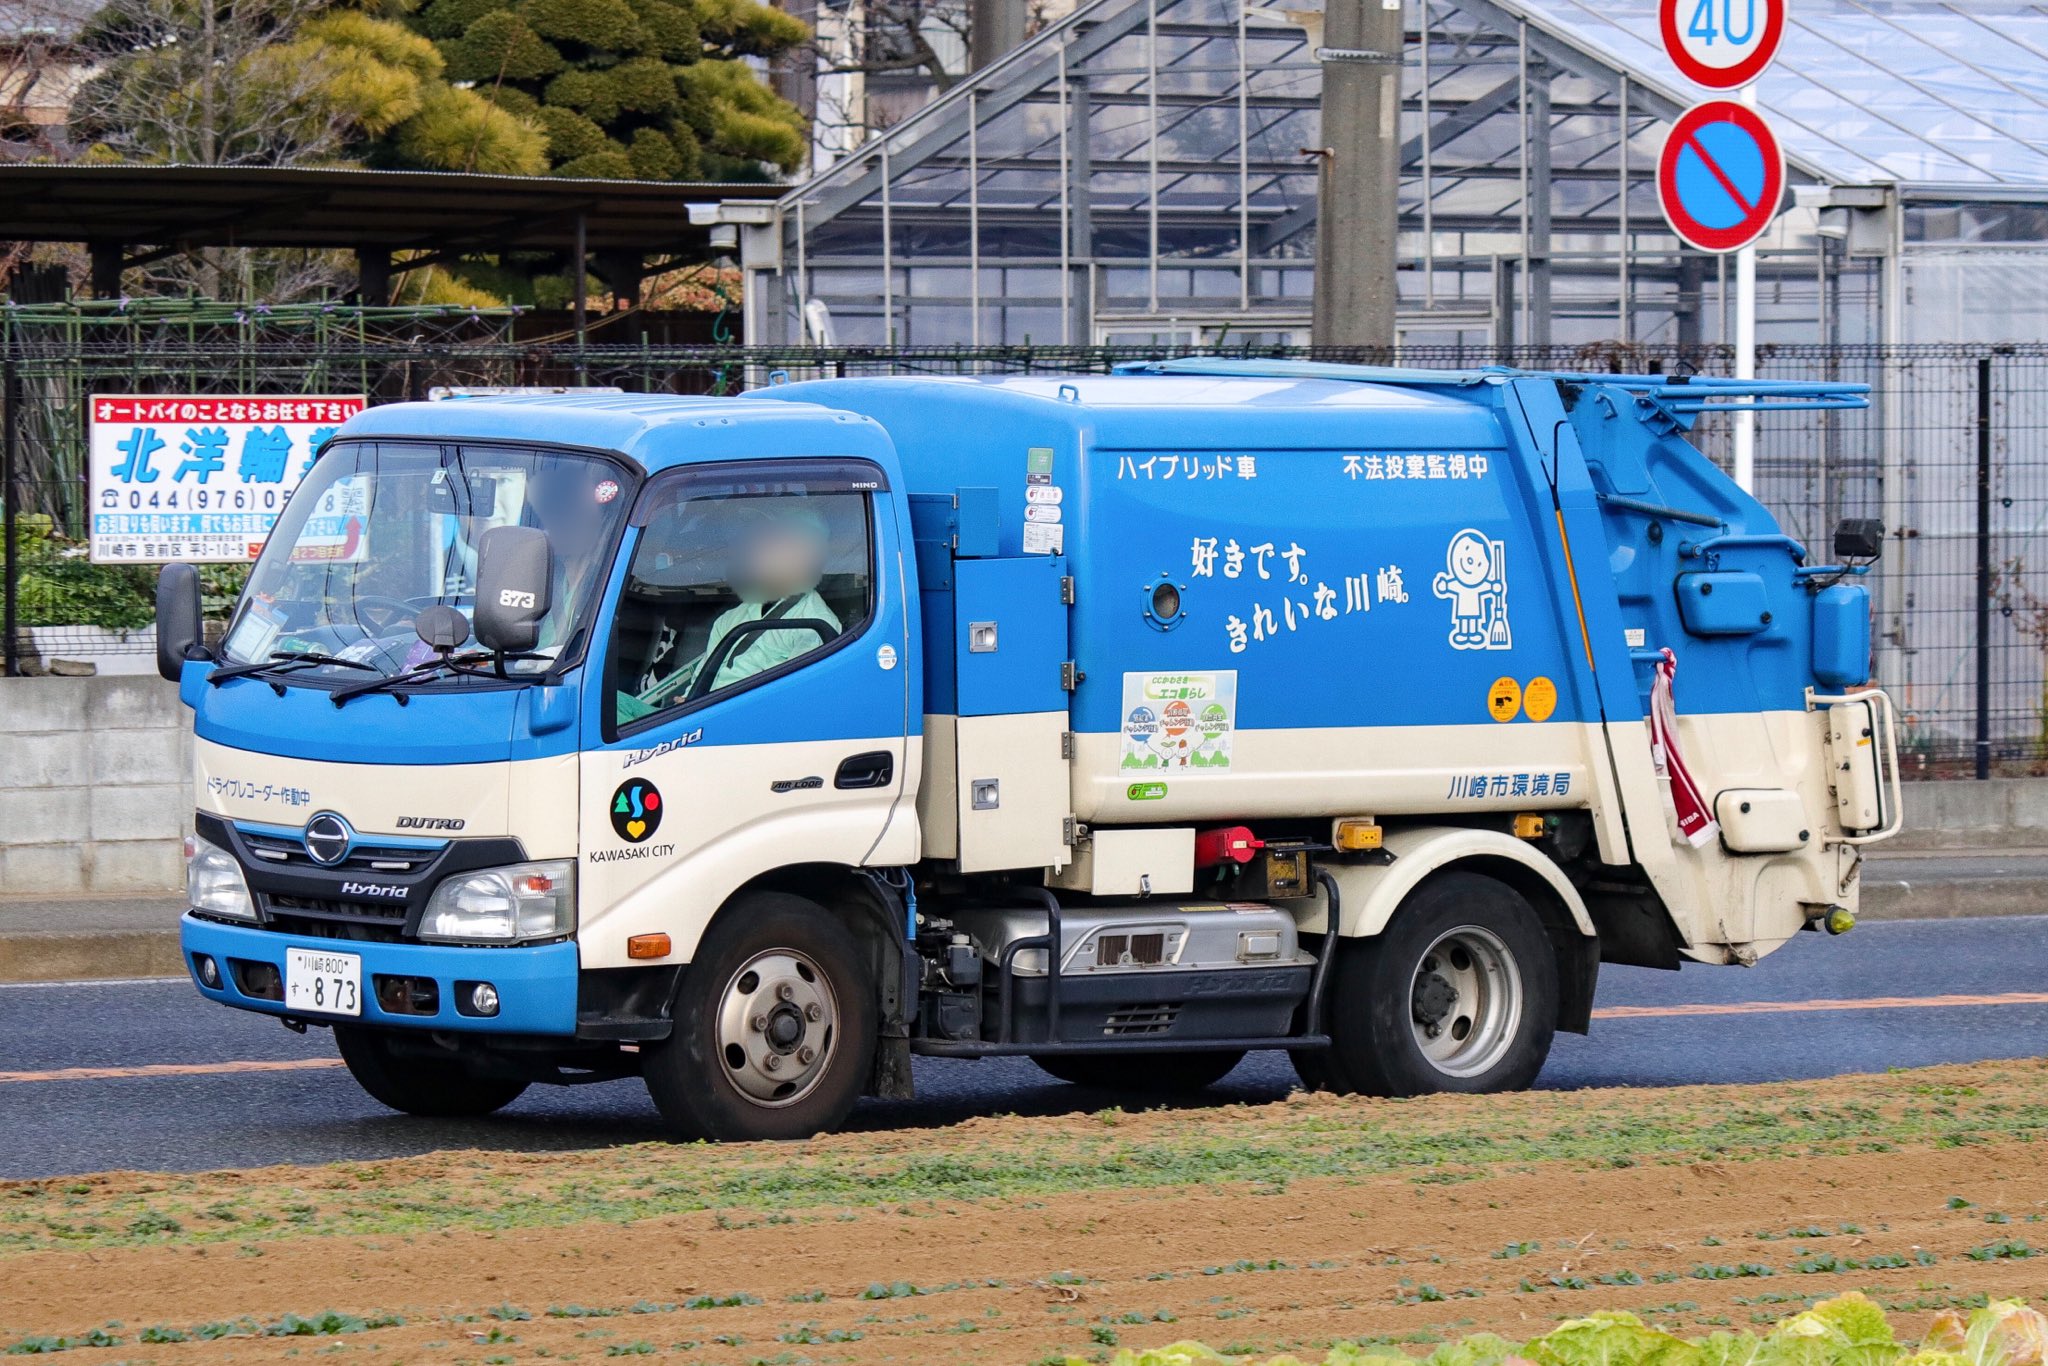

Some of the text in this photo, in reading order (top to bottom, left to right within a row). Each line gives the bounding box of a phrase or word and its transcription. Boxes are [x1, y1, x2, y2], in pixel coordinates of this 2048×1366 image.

[1688, 0, 1754, 46] 40
[99, 402, 358, 421] オートバイのことならお任せ下さい
[1117, 454, 1258, 481] ハイブリッド車
[1342, 454, 1489, 481] 不法投棄監視中
[98, 543, 137, 558] 川崎市
[1191, 537, 1308, 585] 好きです。
[500, 589, 535, 608] 873
[1226, 565, 1409, 653] きれいな川崎。
[623, 728, 704, 769] Hybrid
[207, 776, 310, 806] ドライブレコーダー作動中
[772, 780, 822, 790] AIR LOOP
[1447, 772, 1571, 800] 川崎市環境局
[396, 816, 465, 830] DUTRO
[590, 844, 675, 863] KAWASAKI CITY
[341, 882, 409, 898] Hybrid
